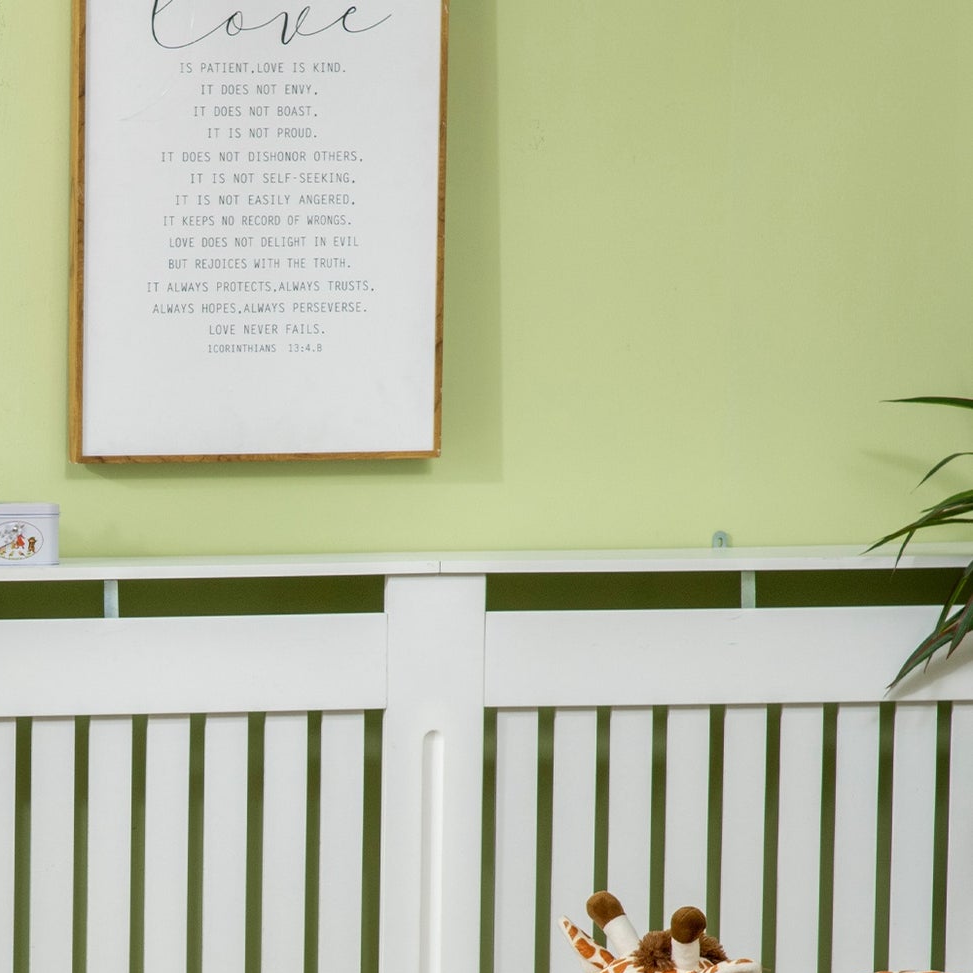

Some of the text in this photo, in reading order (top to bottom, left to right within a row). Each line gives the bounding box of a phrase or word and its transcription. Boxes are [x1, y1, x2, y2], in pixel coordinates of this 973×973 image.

[179, 61, 194, 74] IS
[292, 61, 306, 74] IS
[312, 61, 346, 73] KIND.
[200, 83, 215, 96] IT
[220, 83, 249, 96] DOES
[255, 83, 278, 96] NOT
[193, 105, 207, 118] IT
[213, 105, 243, 118] DOES
[248, 105, 271, 118] NOT
[207, 126, 318, 140] IT IS NOT PROUD.
[161, 151, 175, 163] IT
[181, 151, 212, 163] DOES
[218, 150, 241, 163] NOT
[247, 150, 308, 163] DISHONOR
[190, 172, 204, 185] IT
[211, 172, 226, 185] IS
[232, 172, 256, 185] NOT
[175, 194, 189, 206] IT
[197, 194, 211, 206] IS
[218, 193, 241, 206] NOT
[247, 193, 291, 206] EASILY
[163, 214, 352, 227] IT KEEPS NO RECORD OF WRONGS.
[169, 235, 360, 249] LOVE DOES NOT DELIGHT IN EVIL
[168, 256, 351, 271] BUT REJOICES WITH THE TRUTH.
[146, 281, 160, 293] IT
[166, 281, 209, 293] ALWAYS
[151, 302, 195, 315] ALWAYS
[208, 323, 326, 337] LOVE NEVER FAILS.
